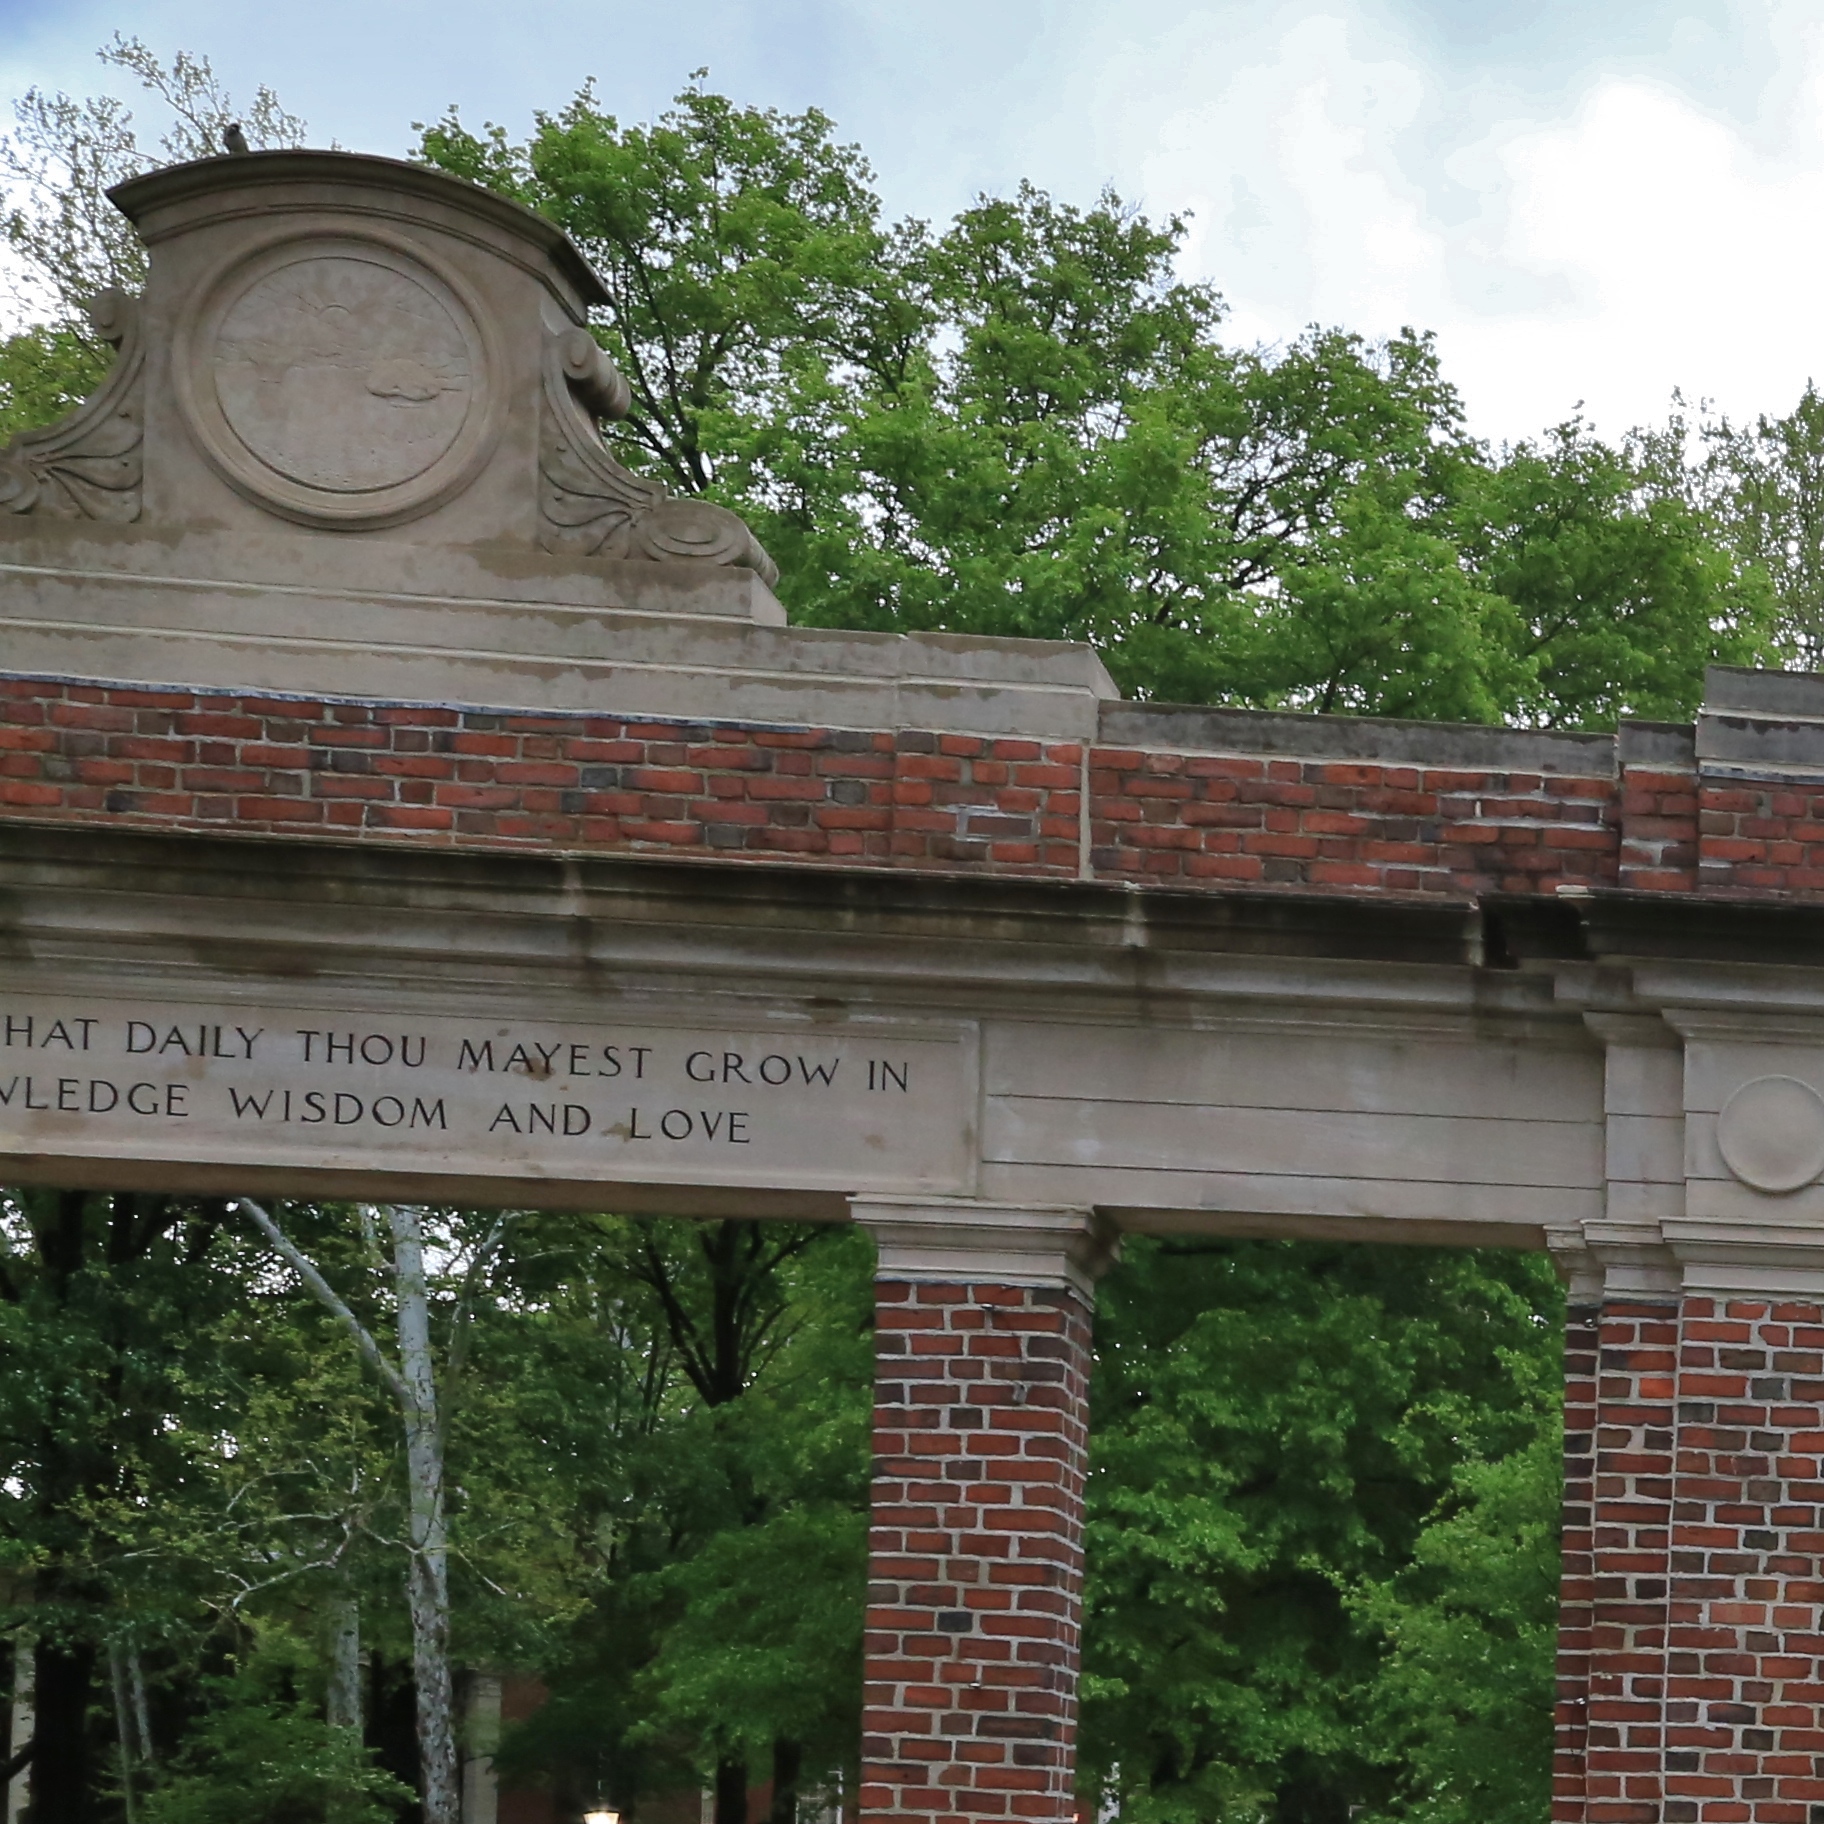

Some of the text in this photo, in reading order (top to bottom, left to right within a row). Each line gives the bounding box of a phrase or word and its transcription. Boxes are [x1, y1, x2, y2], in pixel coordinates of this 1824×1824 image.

[125, 1020, 266, 1060] DAILY
[296, 1029, 427, 1069] THOU
[456, 1038, 654, 1080] MAYEST
[685, 1051, 841, 1089] GROW
[868, 1060, 909, 1094] IN
[227, 1087, 449, 1131] WISDOM
[488, 1102, 593, 1137] AND
[629, 1107, 752, 1144] LOVE
